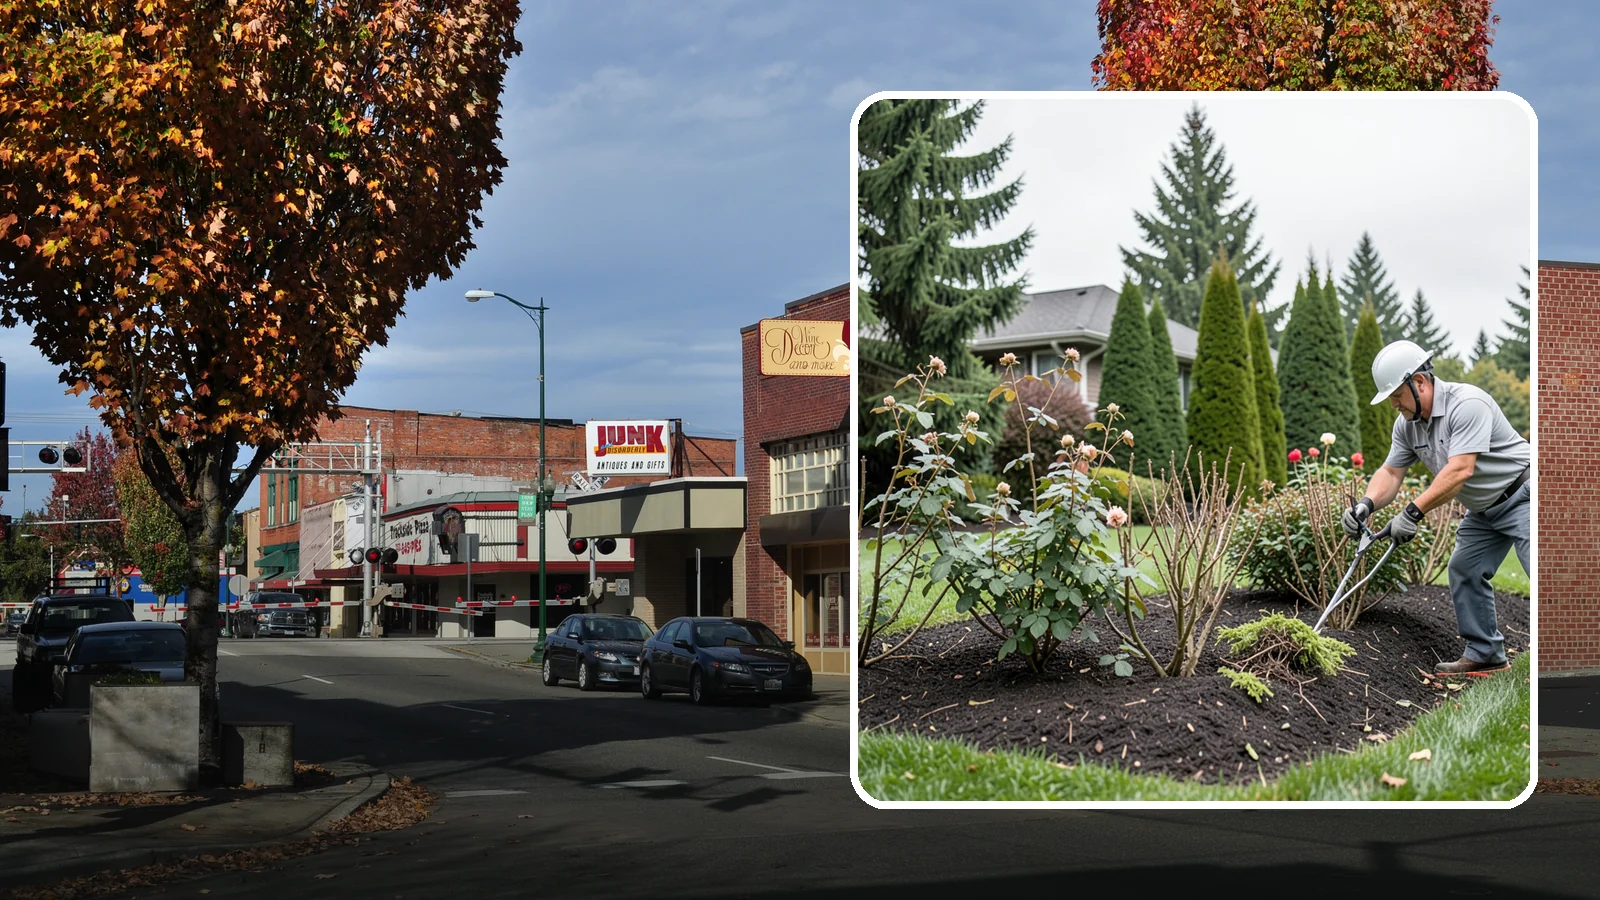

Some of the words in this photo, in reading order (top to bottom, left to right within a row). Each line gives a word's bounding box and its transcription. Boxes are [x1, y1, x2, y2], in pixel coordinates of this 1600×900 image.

[595, 425, 665, 457] JUNK
[607, 446, 646, 454] DISORDERLY
[597, 461, 628, 470] ANTIQUES
[631, 461, 643, 470] AND
[646, 460, 665, 469] GIFTS
[352, 498, 364, 511] CRO
[414, 519, 429, 535] Pizza
